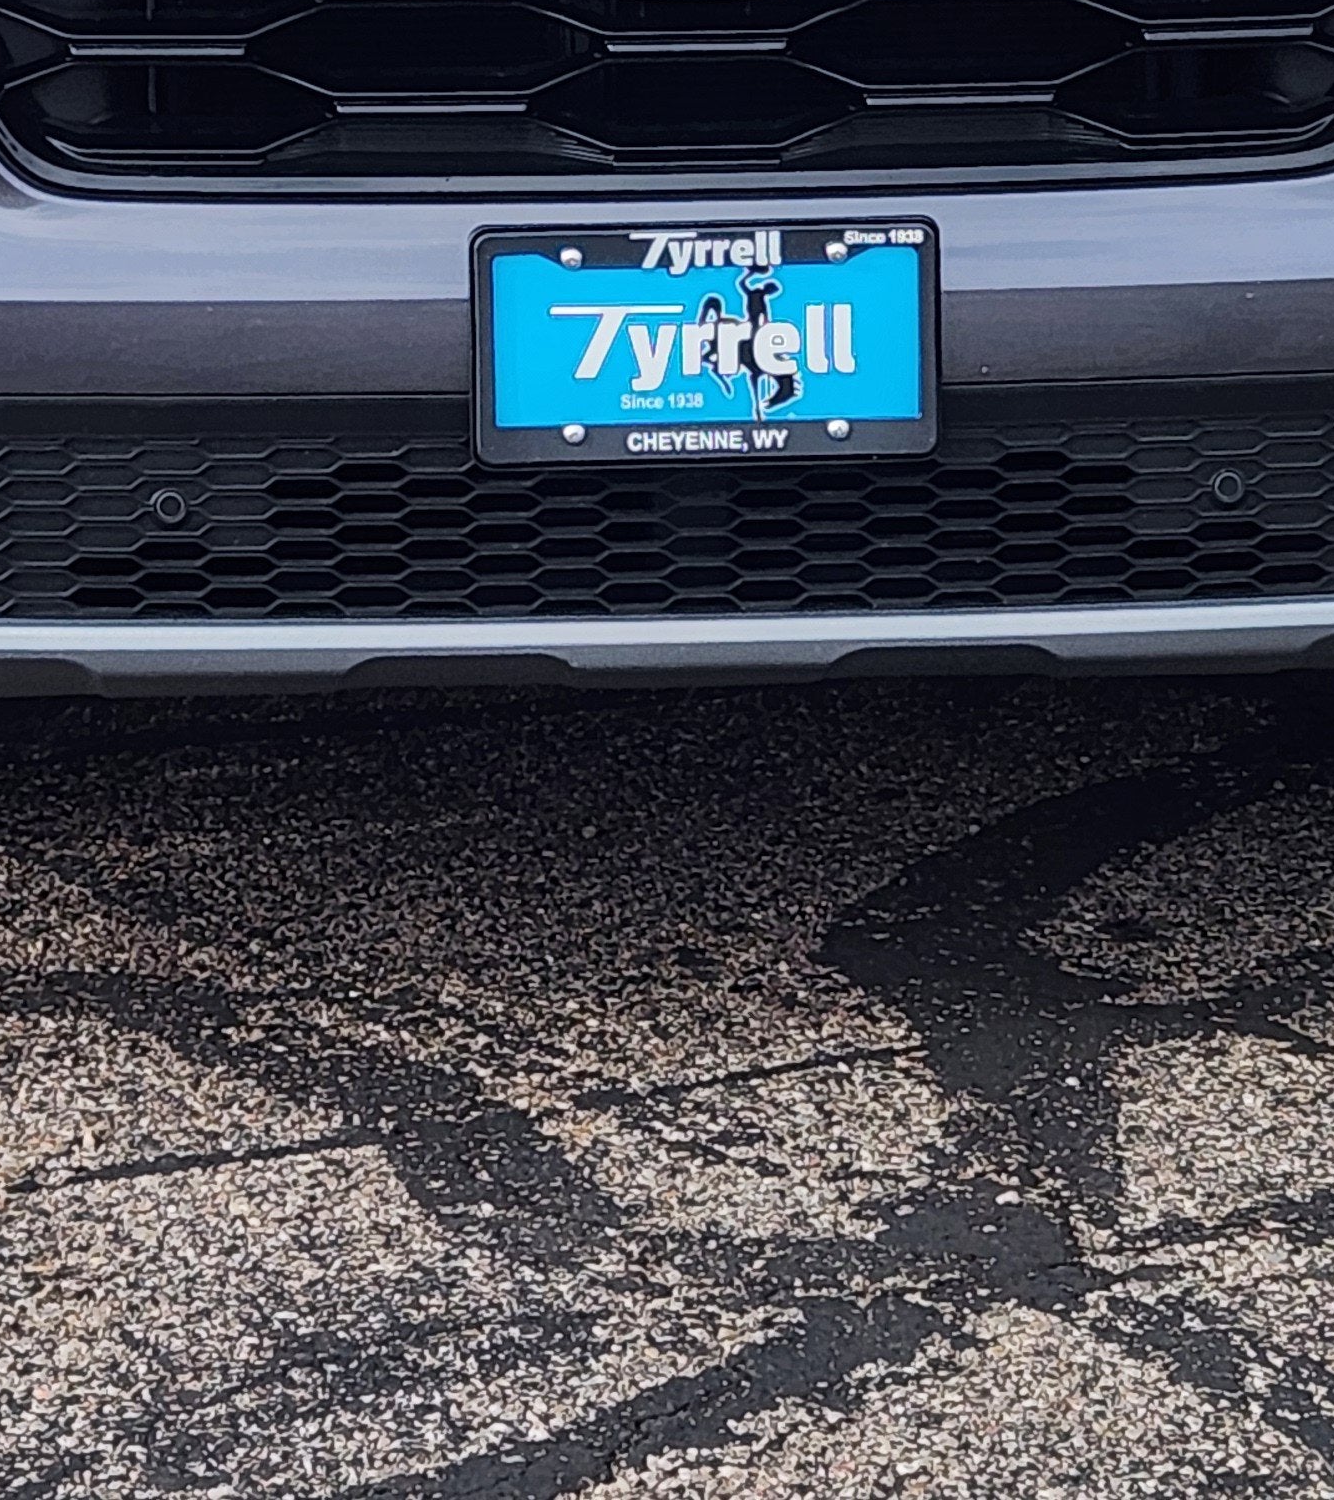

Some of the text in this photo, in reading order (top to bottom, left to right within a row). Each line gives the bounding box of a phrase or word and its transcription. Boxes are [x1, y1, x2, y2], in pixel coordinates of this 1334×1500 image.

[843, 229, 885, 245] Since
[628, 230, 783, 275] Tyrrell
[548, 302, 857, 392] Tyrrell
[620, 393, 665, 410] Since
[626, 427, 789, 453] CHEYENNE, WY
